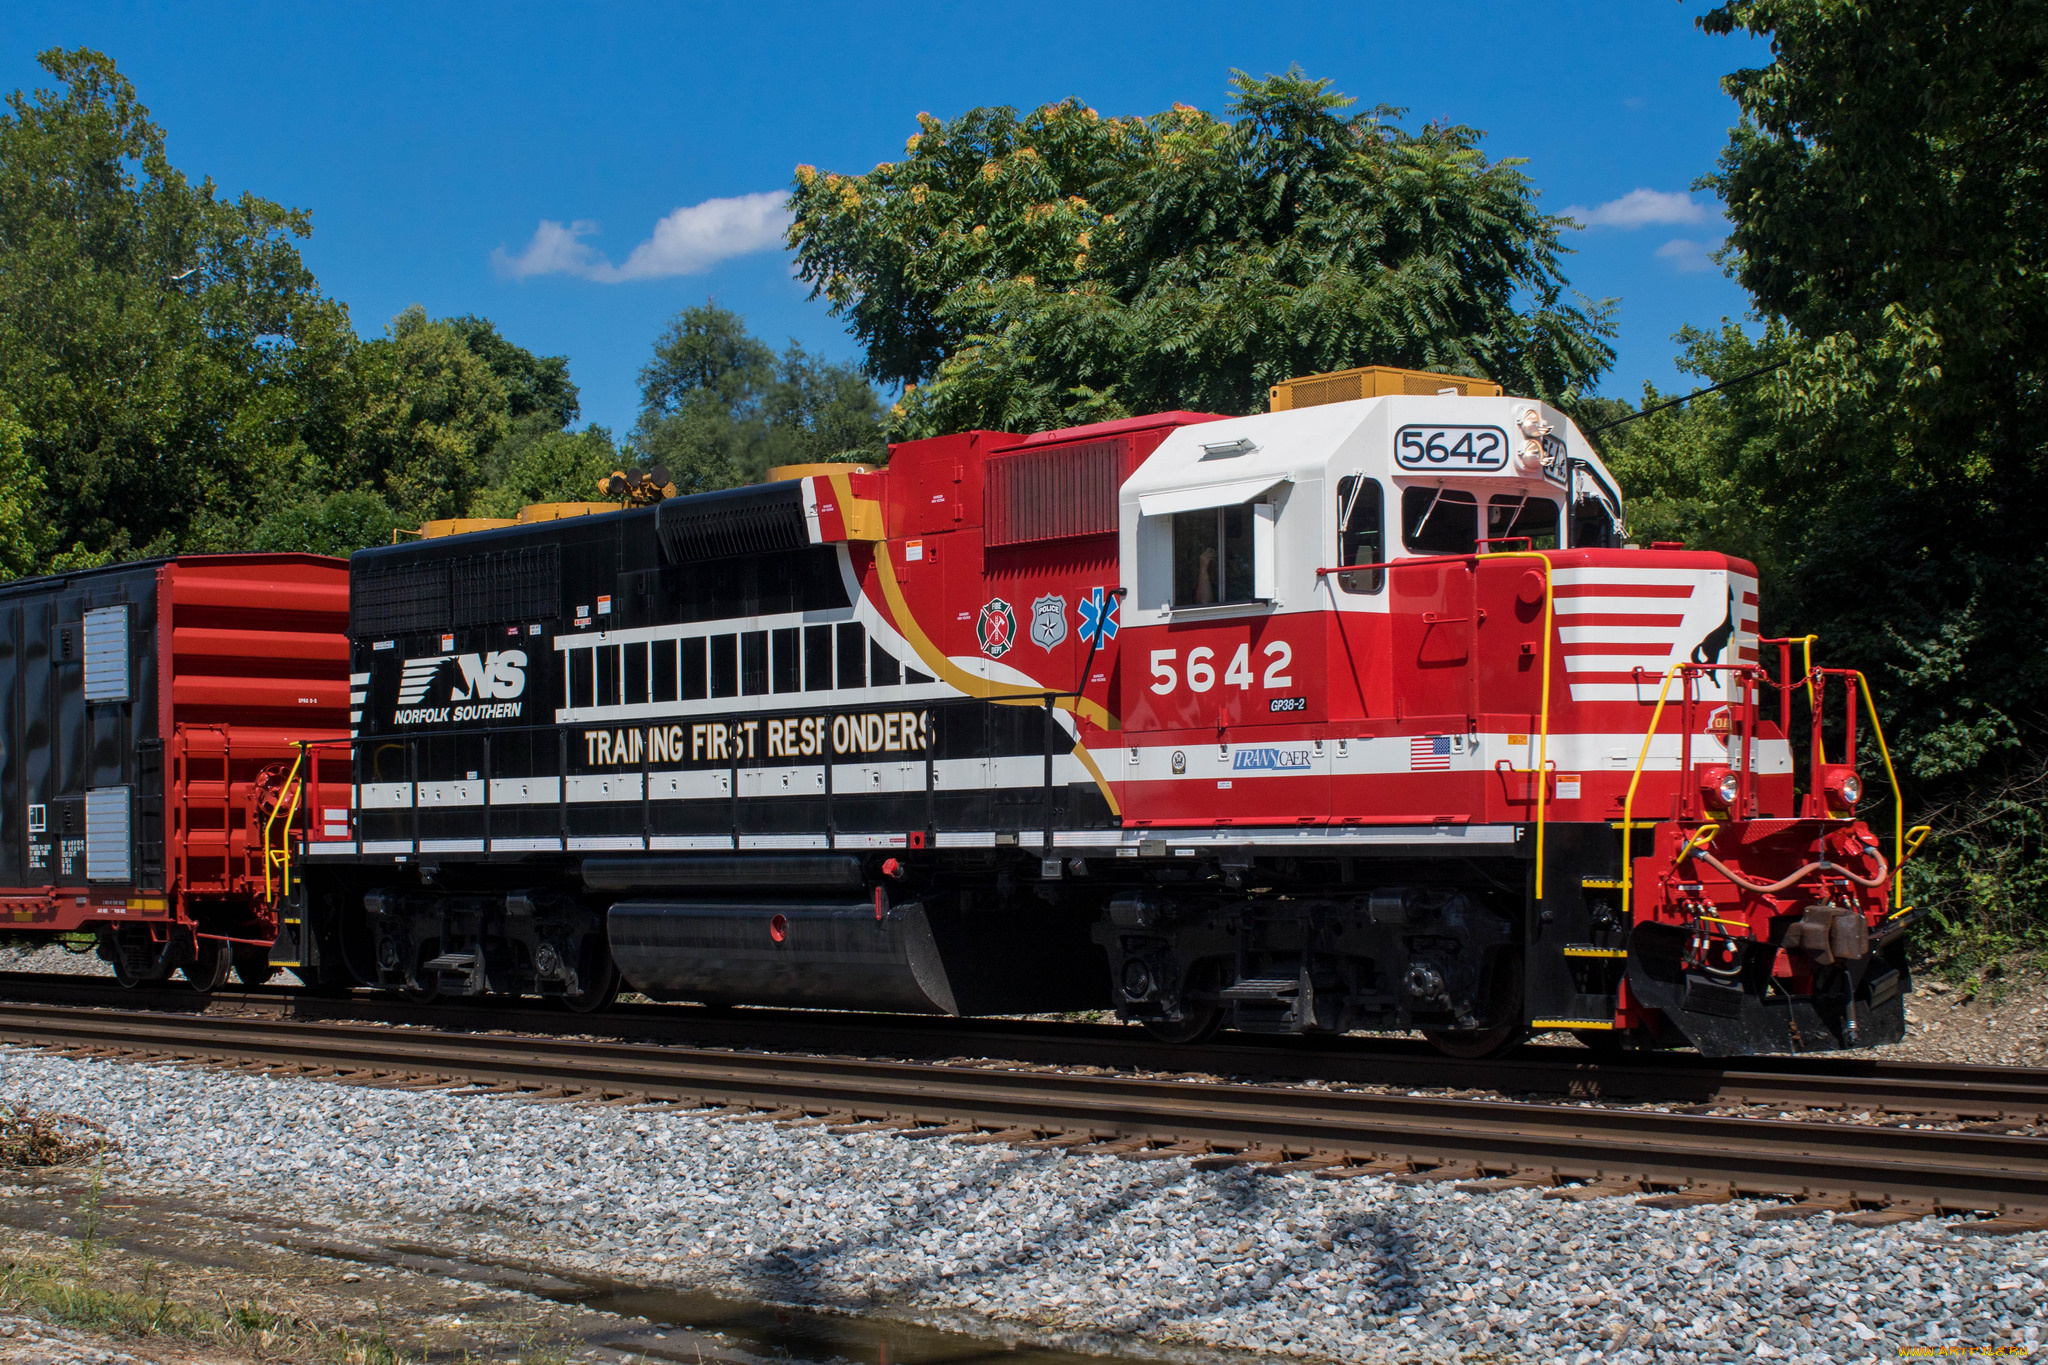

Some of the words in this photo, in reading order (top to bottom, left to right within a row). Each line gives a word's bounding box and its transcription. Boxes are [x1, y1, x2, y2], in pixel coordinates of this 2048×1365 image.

[1402, 431, 1500, 464] 5642
[991, 602, 1002, 610] FIRE
[1038, 604, 1060, 615] POLICE
[991, 646, 1002, 654] DEPT
[450, 650, 528, 702] NS
[1150, 640, 1292, 695] 5642
[394, 707, 451, 725] NORFOLK
[453, 702, 522, 722] SOUTHERN
[1270, 698, 1305, 712] GP38-2
[584, 725, 684, 766] TRAINING
[692, 721, 759, 761] FIRST
[768, 710, 936, 757] RESPONDERS
[1235, 749, 1312, 769] TRANSCAER
[1515, 827, 1526, 842] F
